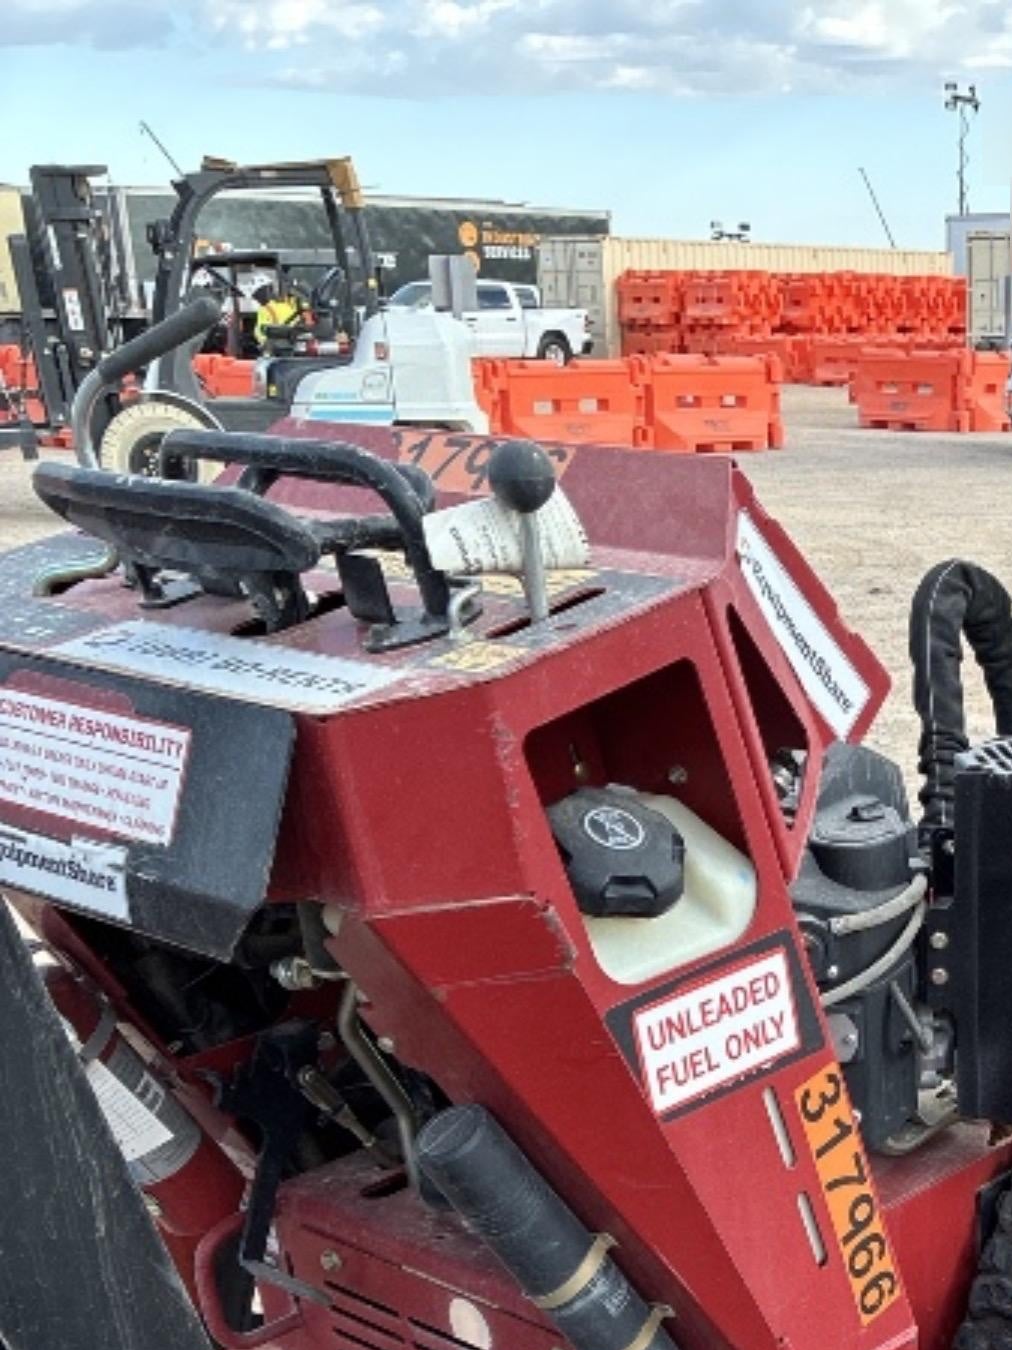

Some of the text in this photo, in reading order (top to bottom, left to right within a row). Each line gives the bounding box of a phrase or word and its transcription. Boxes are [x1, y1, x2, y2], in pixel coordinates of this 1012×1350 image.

[0, 698, 184, 758] CUSTOMER RESPONSIBILITY
[646, 971, 781, 1051] UNLEADED
[655, 1010, 785, 1096] FUEL ONLY
[800, 1073, 897, 1316] 317966
